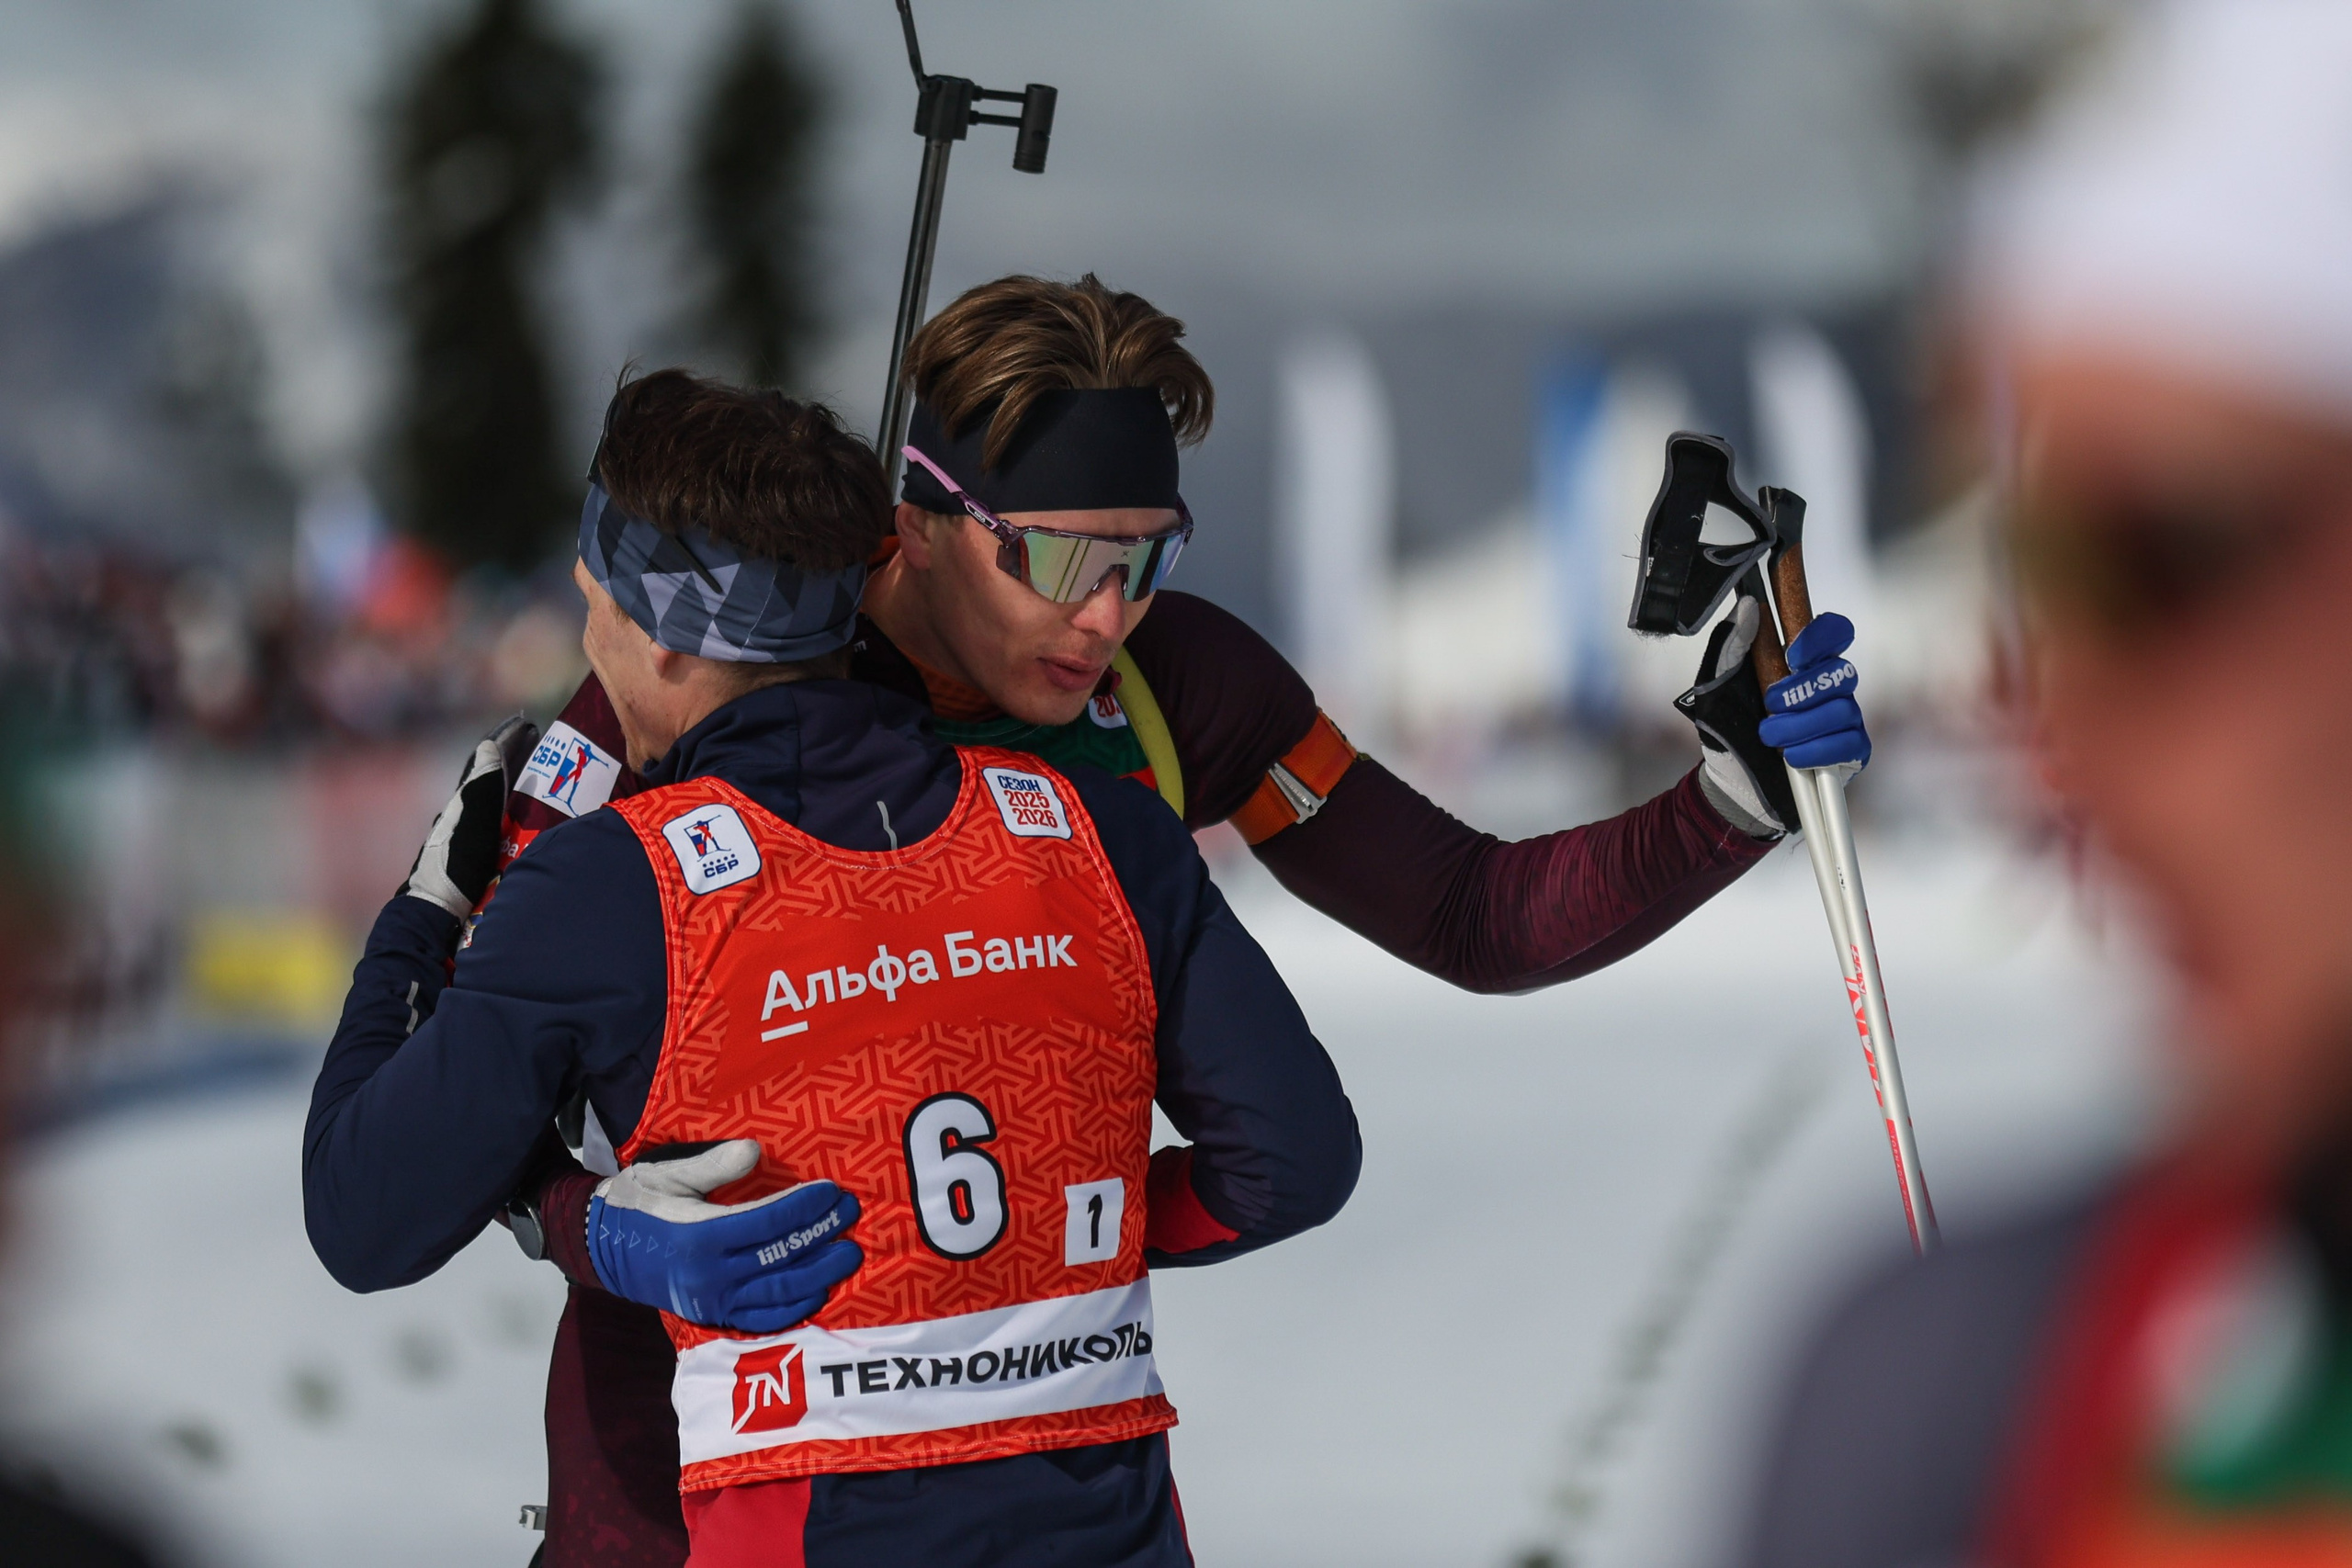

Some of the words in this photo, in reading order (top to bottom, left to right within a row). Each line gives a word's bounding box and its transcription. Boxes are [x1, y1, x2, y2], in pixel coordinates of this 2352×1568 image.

[1782, 663, 1856, 707] lill-Spo
[532, 745, 561, 768] СБР
[997, 775, 1042, 792] СЕЗОН
[1003, 790, 1050, 808] 2025
[1012, 808, 1058, 829] 2026
[704, 859, 739, 878] СБР
[761, 944, 939, 1024] Альфа
[944, 931, 1078, 977] Банк
[902, 1091, 1010, 1262] 6
[1087, 1193, 1102, 1248] 1
[820, 1321, 1153, 1398] ТЕХНОНИКОЛЬ
